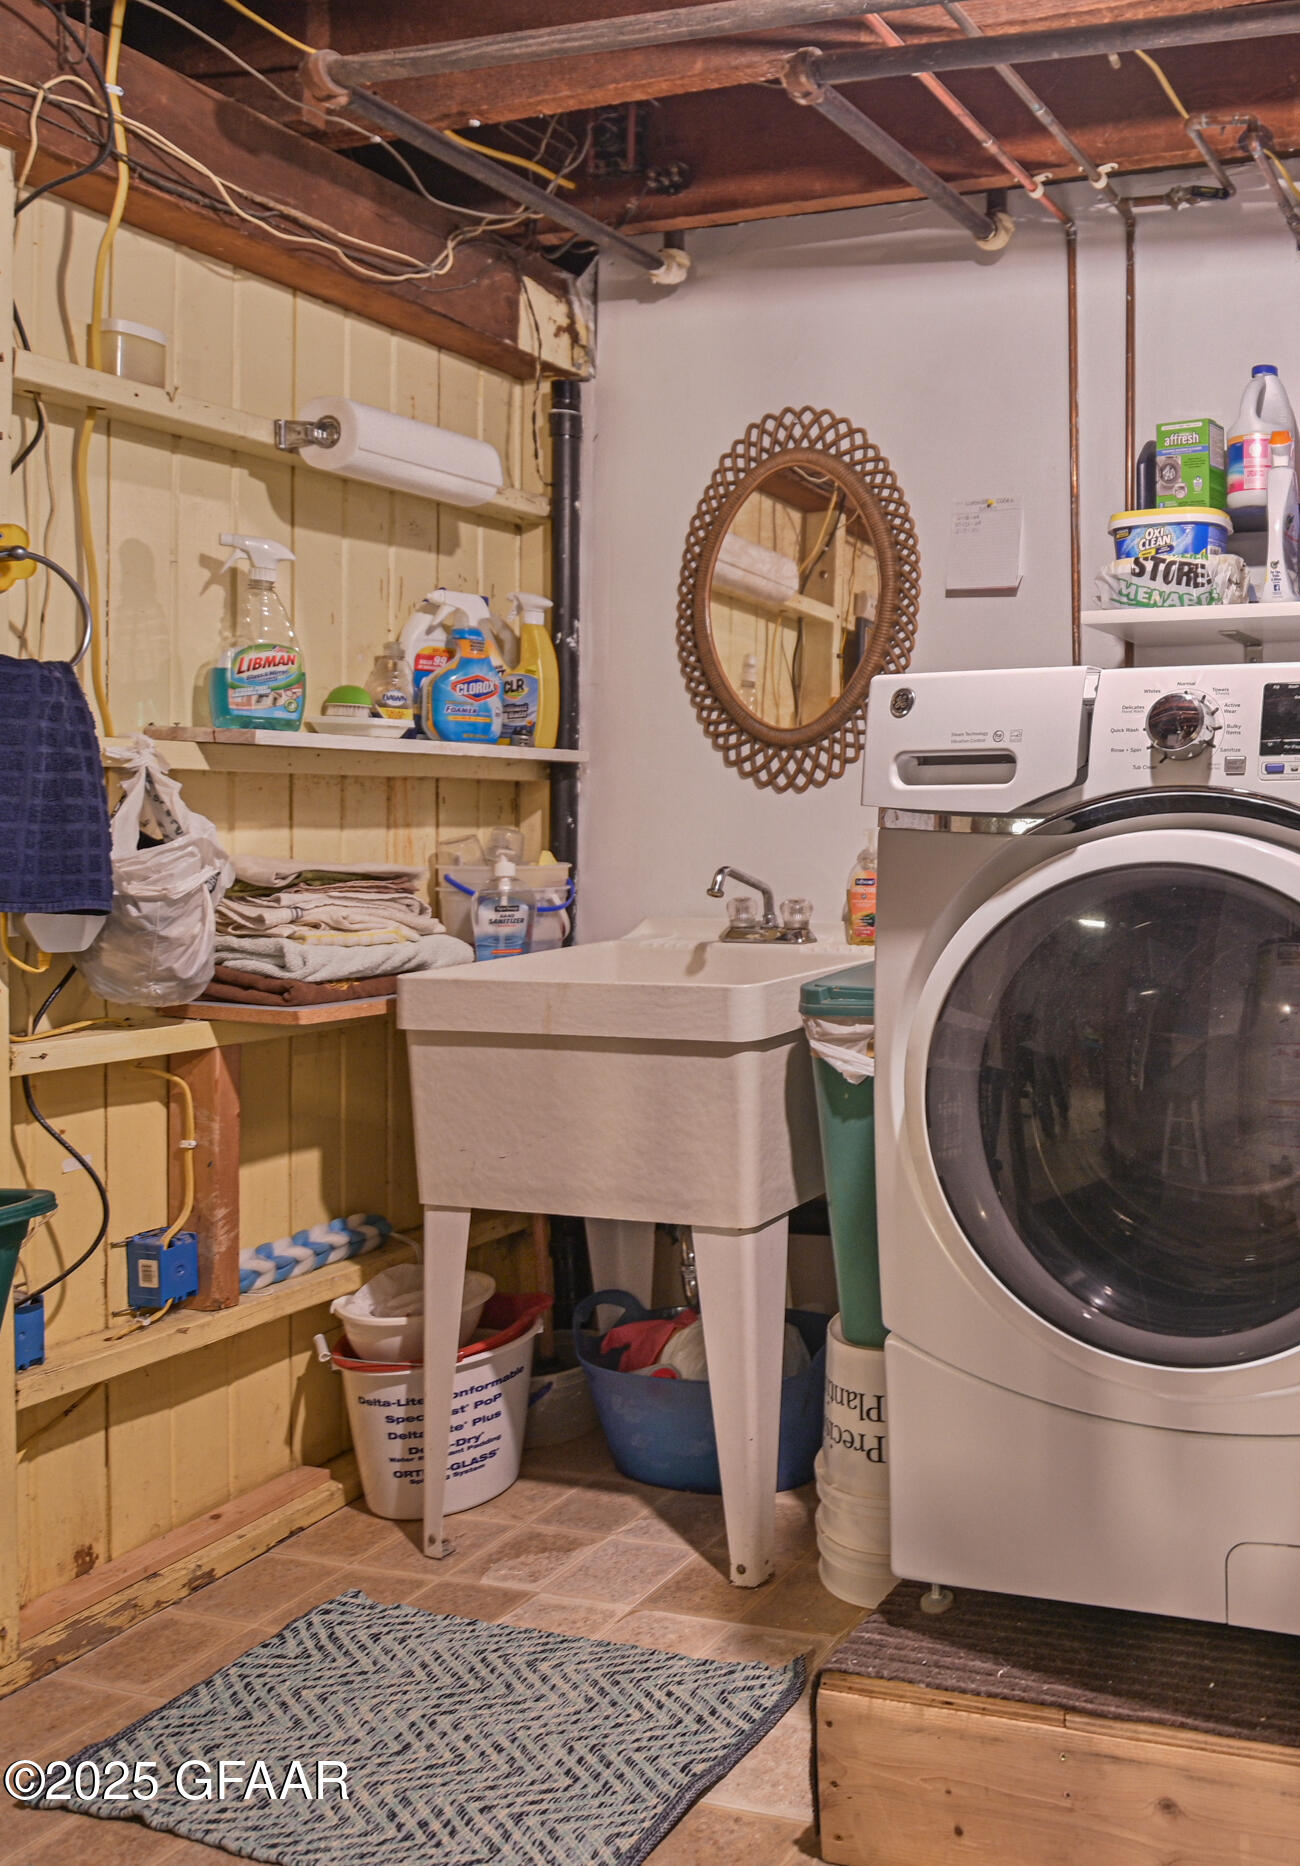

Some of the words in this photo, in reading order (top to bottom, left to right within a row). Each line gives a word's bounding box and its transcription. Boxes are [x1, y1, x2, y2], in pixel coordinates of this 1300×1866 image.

[1164, 431, 1200, 447] affresh
[1145, 527, 1165, 540] OXI
[1138, 534, 1172, 551] CLEAN
[236, 654, 297, 675] LIBMAN
[455, 679, 496, 696] CLOROX
[504, 677, 525, 694] CLR
[488, 917, 525, 925] SANITIZER
[357, 1395, 425, 1408] Delta-Lite
[453, 1365, 525, 1400] onformable
[473, 1392, 503, 1410] PoP
[471, 1410, 502, 1427] Plus
[453, 1463, 486, 1477] System
